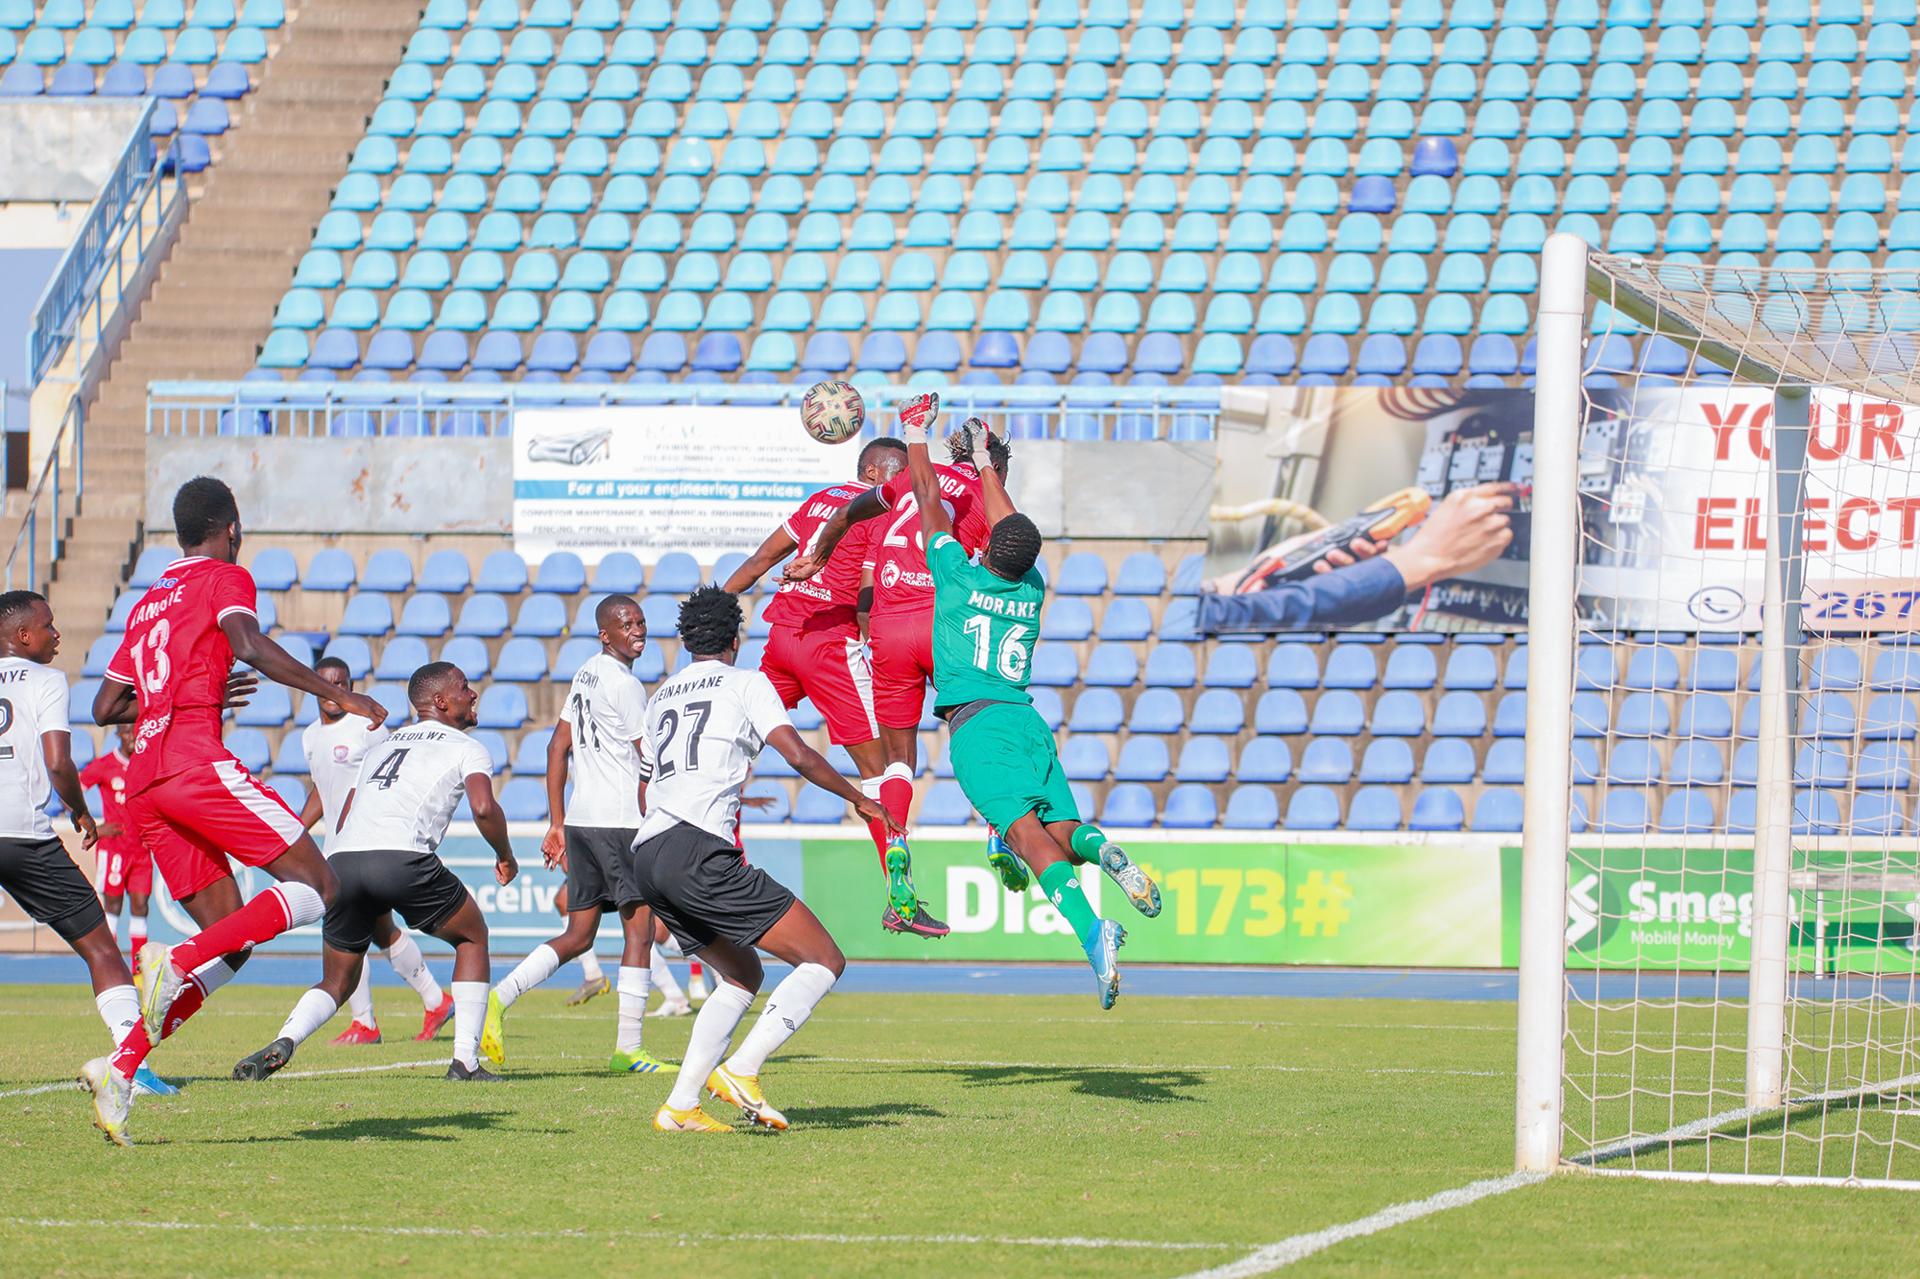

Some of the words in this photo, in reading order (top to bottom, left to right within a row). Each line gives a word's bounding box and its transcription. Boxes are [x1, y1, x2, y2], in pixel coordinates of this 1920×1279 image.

[567, 481, 593, 496] For
[596, 482, 614, 496] all
[617, 483, 651, 499] your
[653, 483, 738, 500] engineering
[741, 484, 804, 498] services
[966, 590, 1037, 619] MORAKE
[130, 618, 171, 708] 13
[963, 613, 1030, 682] 16
[655, 700, 712, 783] 27
[366, 747, 412, 791] 4
[1630, 931, 1681, 945] Mobile
[1684, 931, 1735, 949] Money
